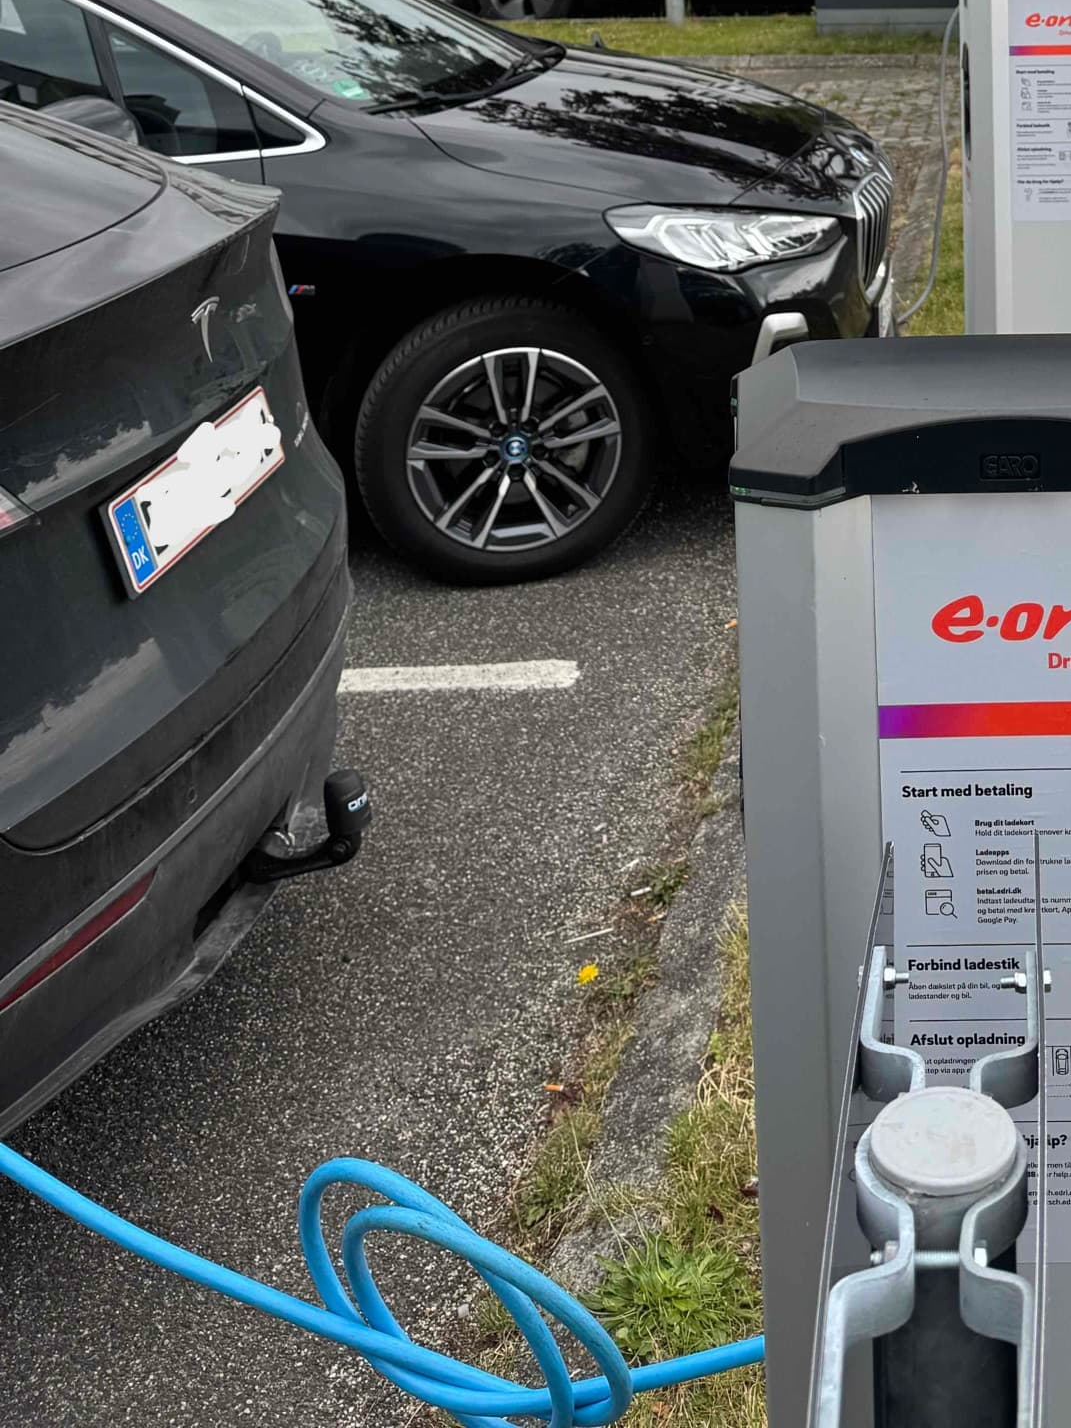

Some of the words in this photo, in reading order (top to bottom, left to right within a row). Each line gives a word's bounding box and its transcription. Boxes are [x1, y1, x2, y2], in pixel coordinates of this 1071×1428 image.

[131, 544, 149, 570] DK
[902, 785, 938, 798] Start
[941, 784, 972, 797] med
[975, 783, 1032, 799] betaling
[975, 819, 992, 827] Brug
[1004, 828, 1033, 836] ladekort
[976, 849, 1010, 857] Ladeapps
[976, 858, 1012, 866] Download
[976, 887, 1022, 895] betal.edri.dk
[977, 916, 1003, 925] Google
[908, 959, 961, 971] Forbind
[964, 958, 1020, 970] ladestik
[908, 981, 928, 990] Åben
[957, 981, 967, 991] på
[968, 981, 979, 989] din
[908, 993, 949, 1001] ladestander
[910, 1034, 954, 1046] Afslut
[956, 1033, 1026, 1049] opladning
[933, 1057, 976, 1066] opladningen
[940, 1066, 951, 1074] via
[951, 1067, 965, 1075] app
